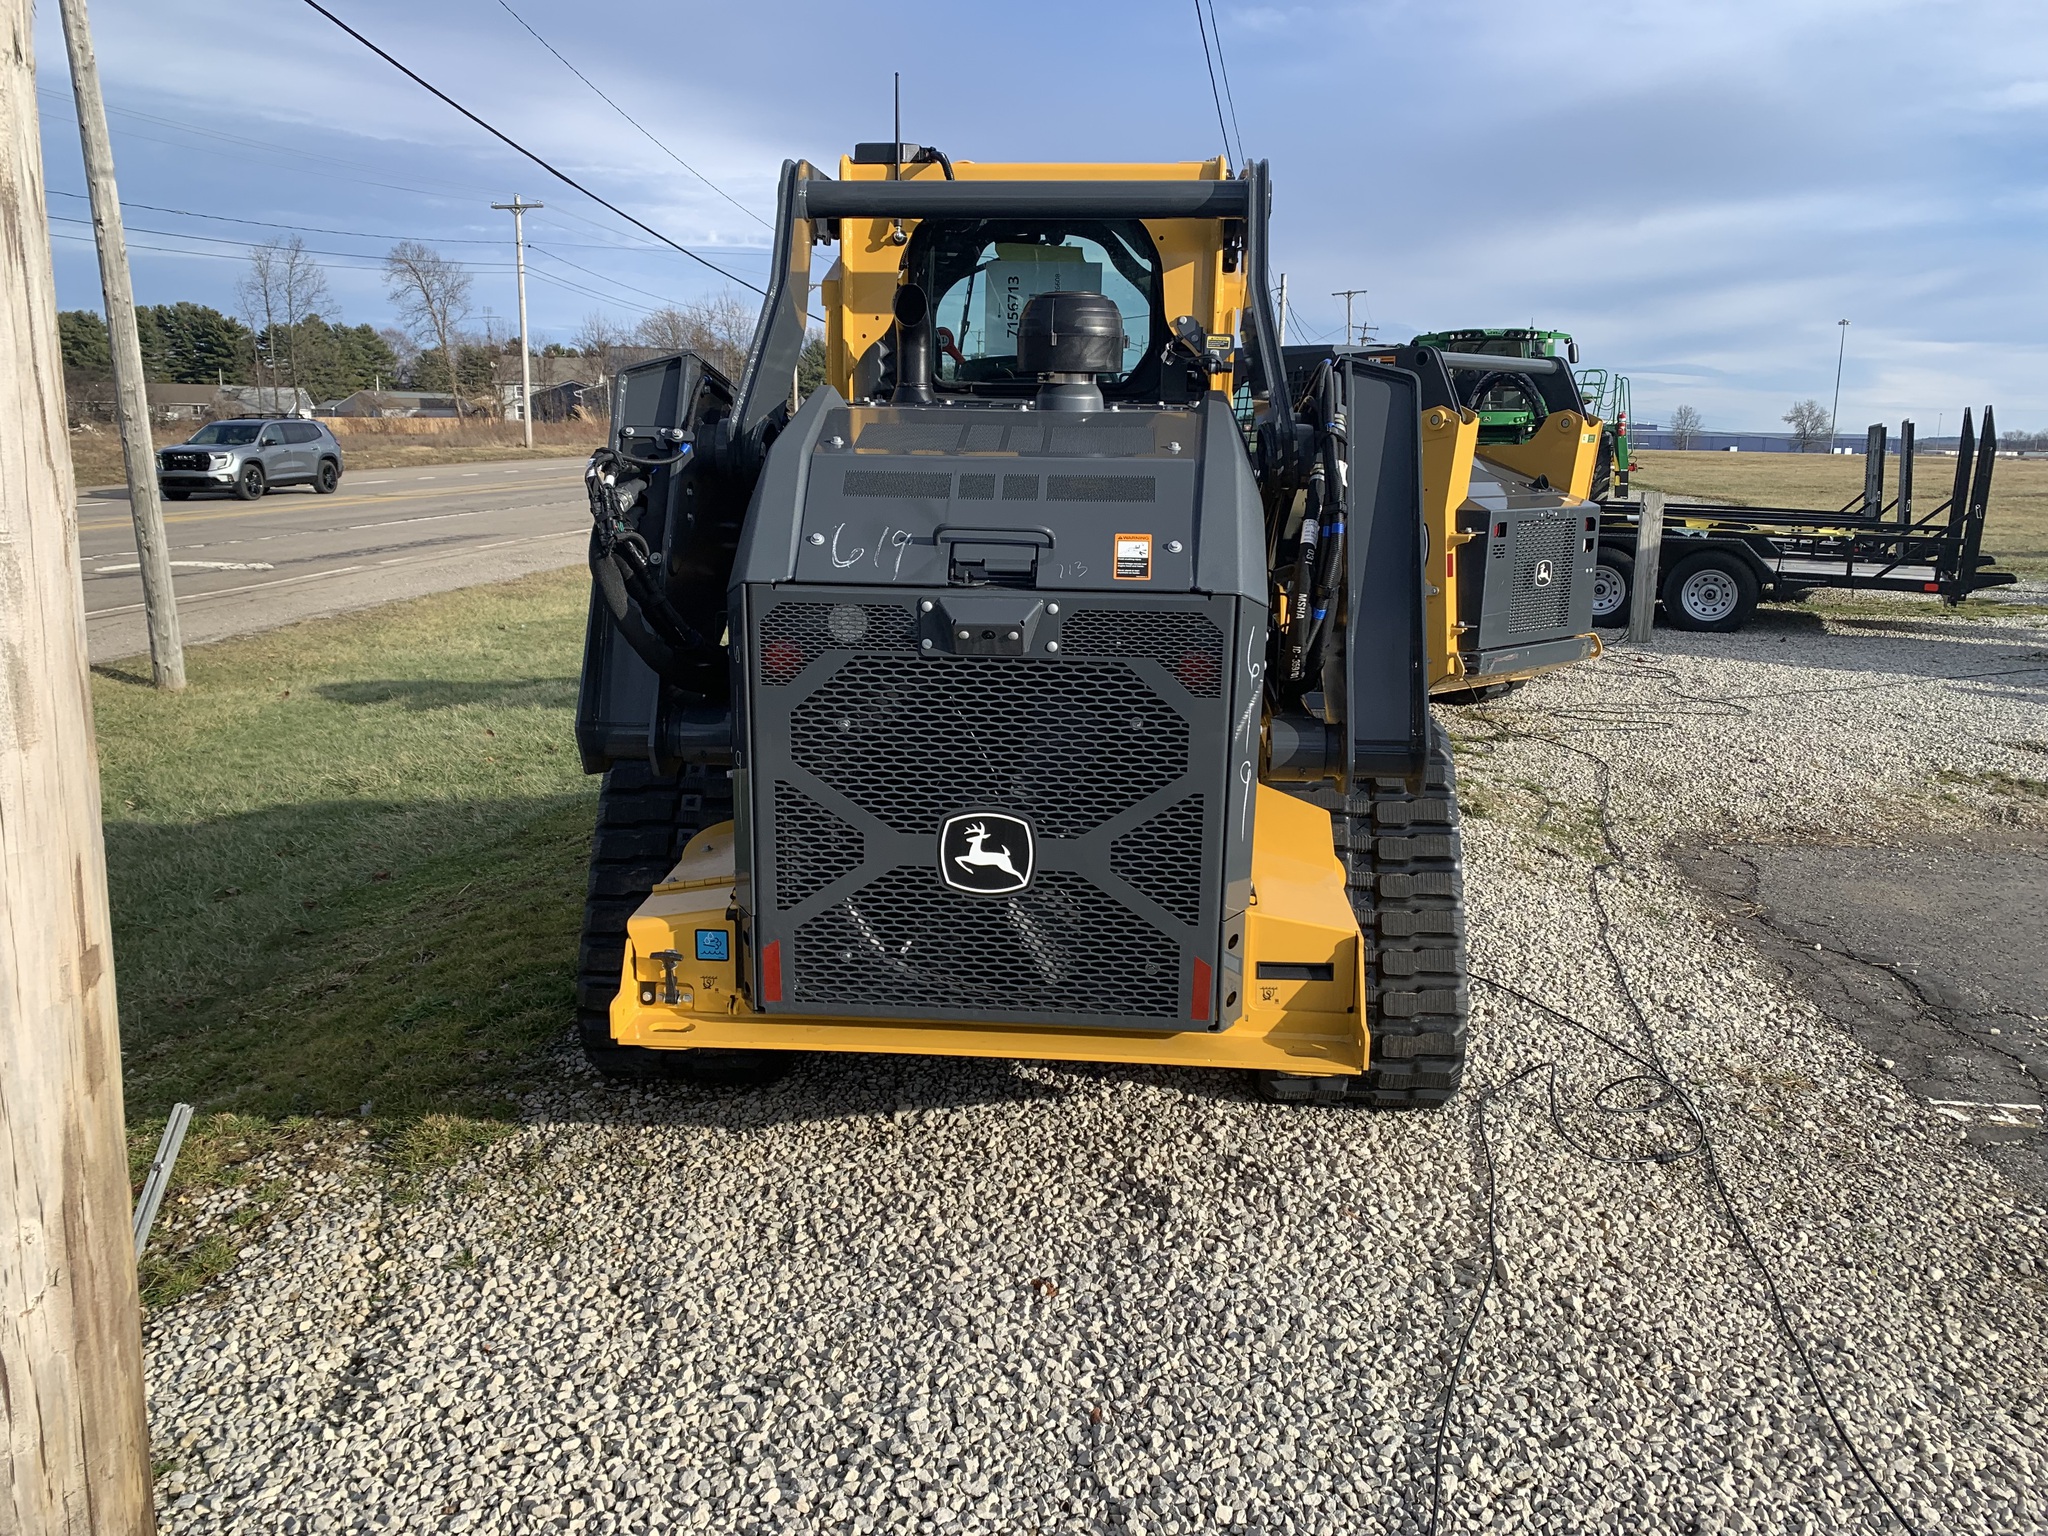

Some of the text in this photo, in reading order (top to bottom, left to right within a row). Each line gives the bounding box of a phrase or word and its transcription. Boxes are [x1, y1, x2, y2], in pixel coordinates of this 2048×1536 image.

[1006, 275, 1019, 338] 7156713
[831, 522, 914, 581] 619
[1296, 594, 1307, 619] MSHA
